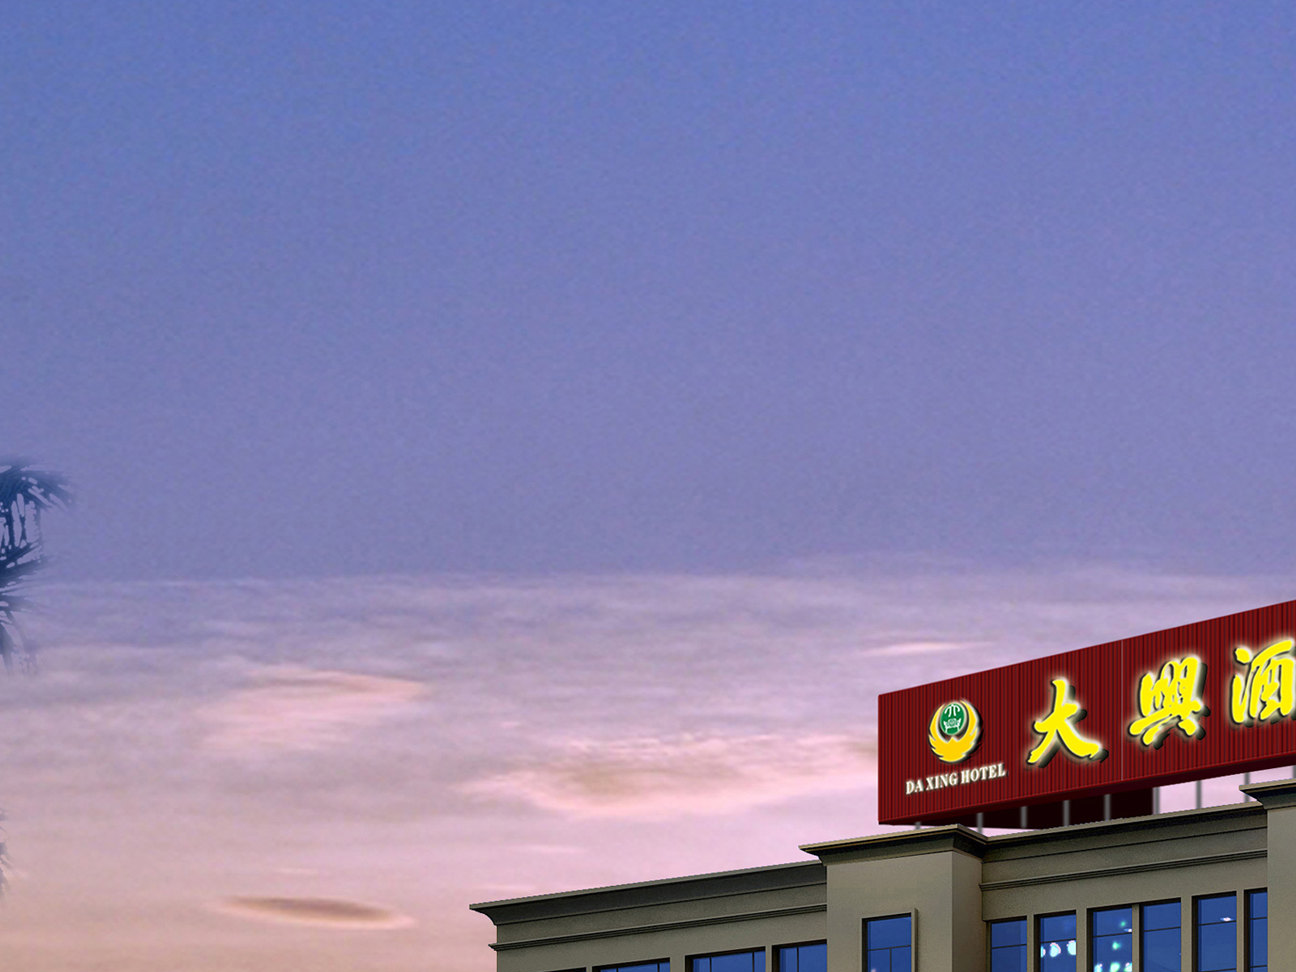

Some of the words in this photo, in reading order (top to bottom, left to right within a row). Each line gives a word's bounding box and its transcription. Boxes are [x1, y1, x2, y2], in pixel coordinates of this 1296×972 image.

[905, 779, 924, 795] DA
[925, 772, 959, 791] XING
[960, 762, 1007, 785] HOTEL
